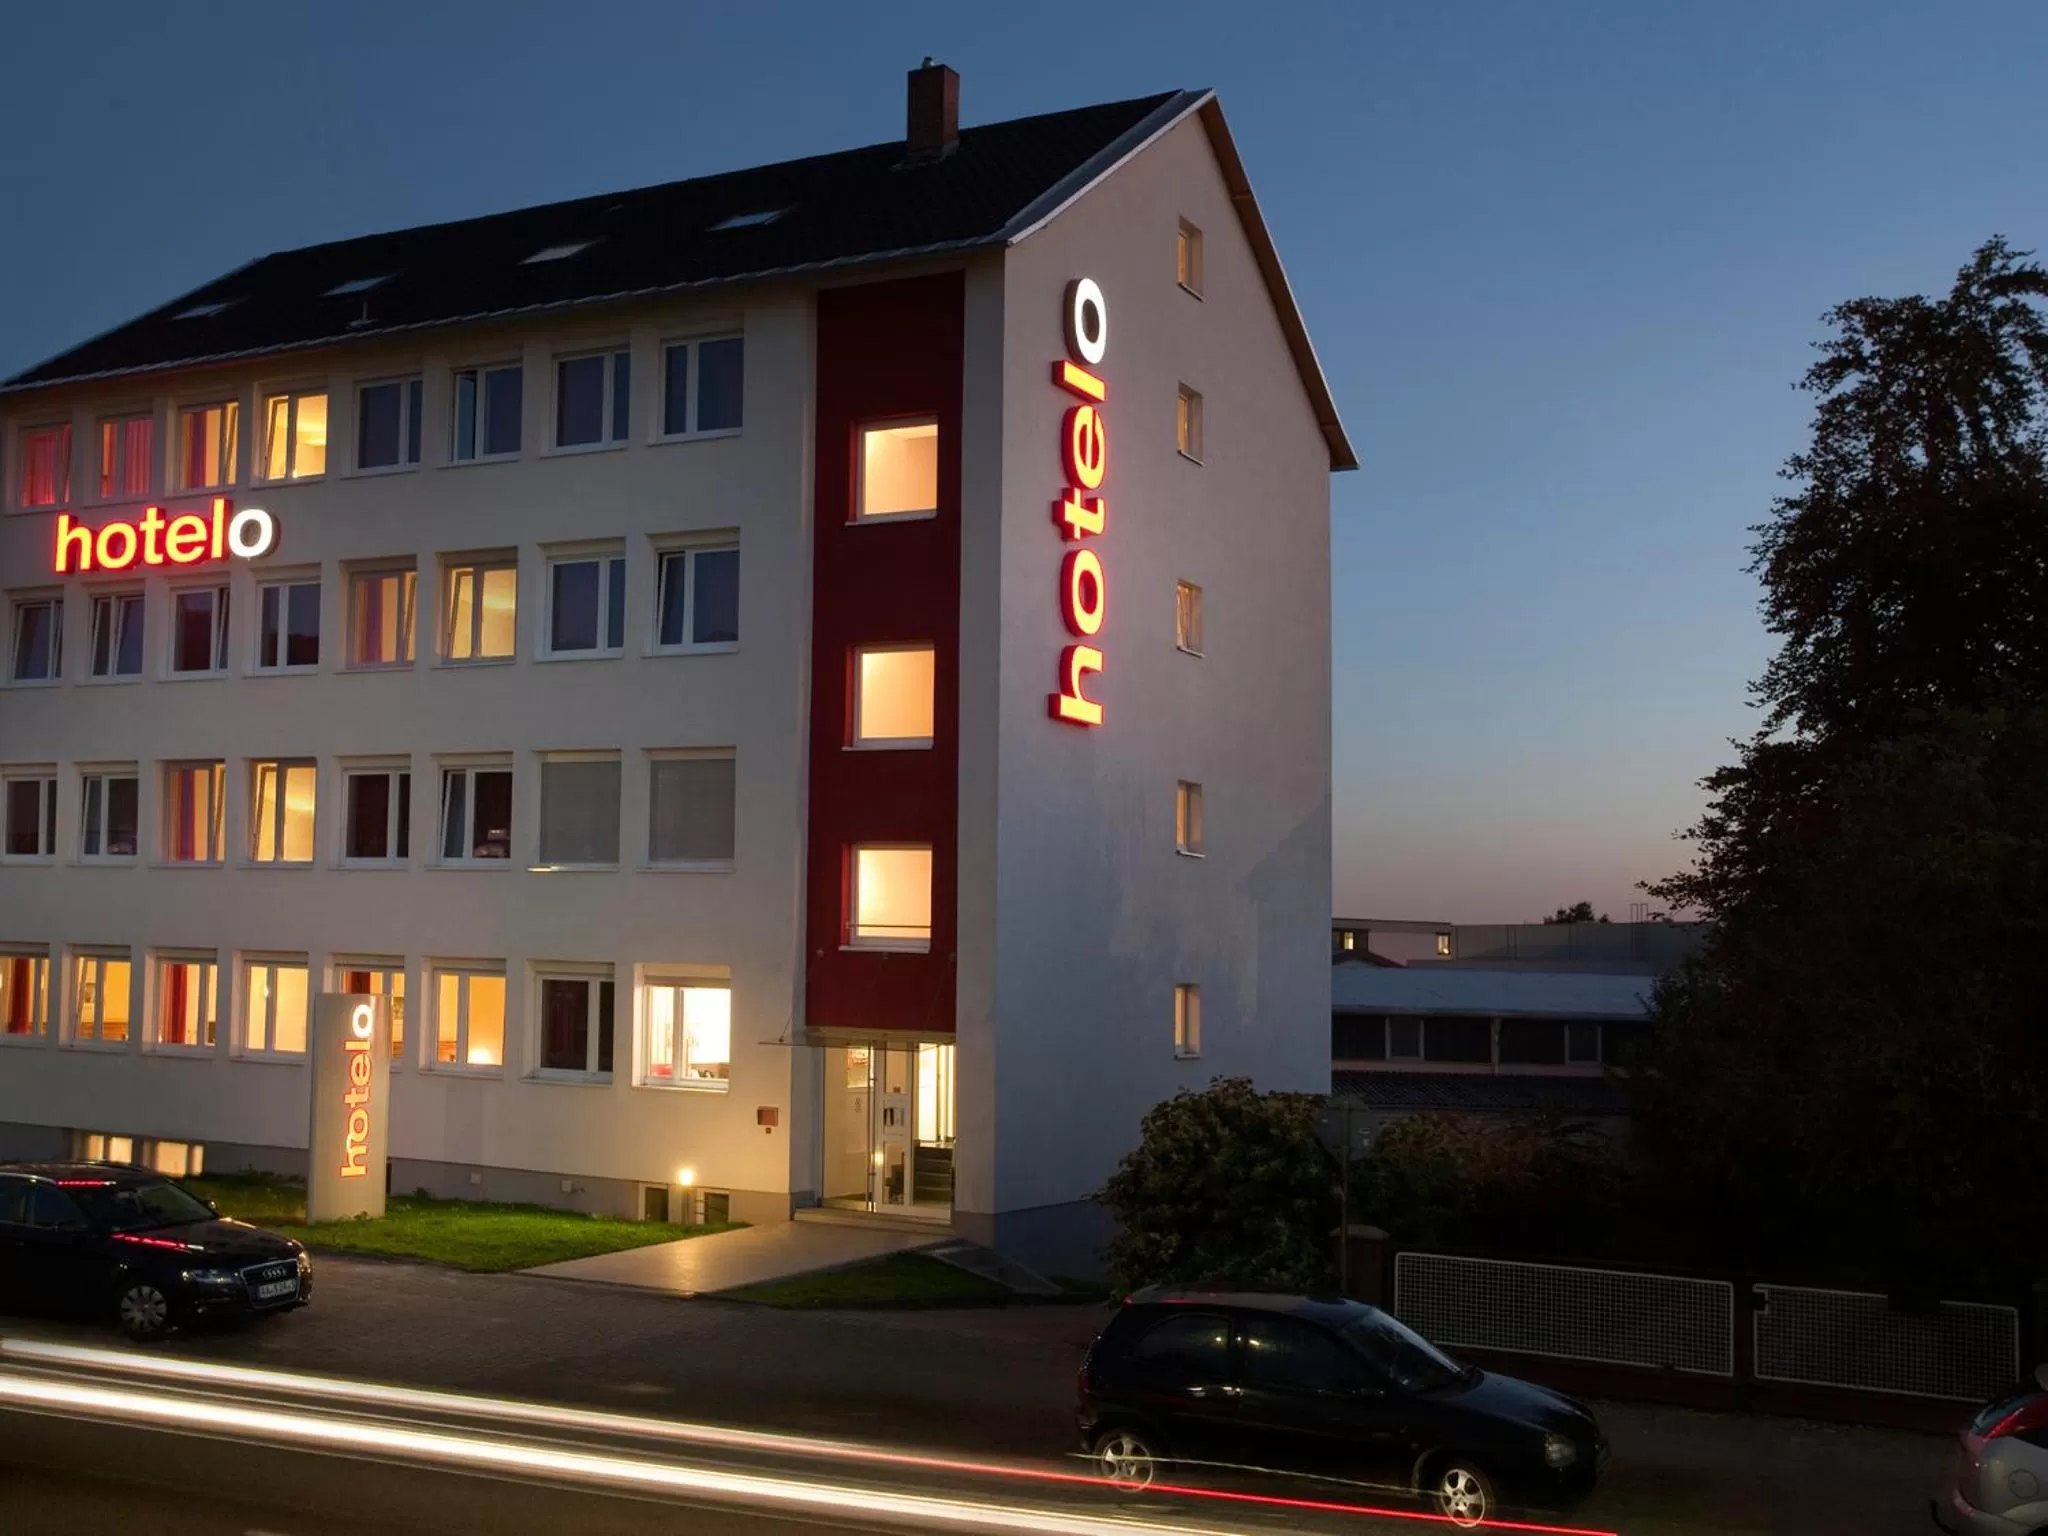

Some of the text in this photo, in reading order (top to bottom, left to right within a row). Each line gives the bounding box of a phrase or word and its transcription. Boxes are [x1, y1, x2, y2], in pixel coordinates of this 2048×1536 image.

[54, 497, 277, 574] hotelo
[1052, 277, 1107, 727] hotelo
[341, 1003, 373, 1178] hotelo
